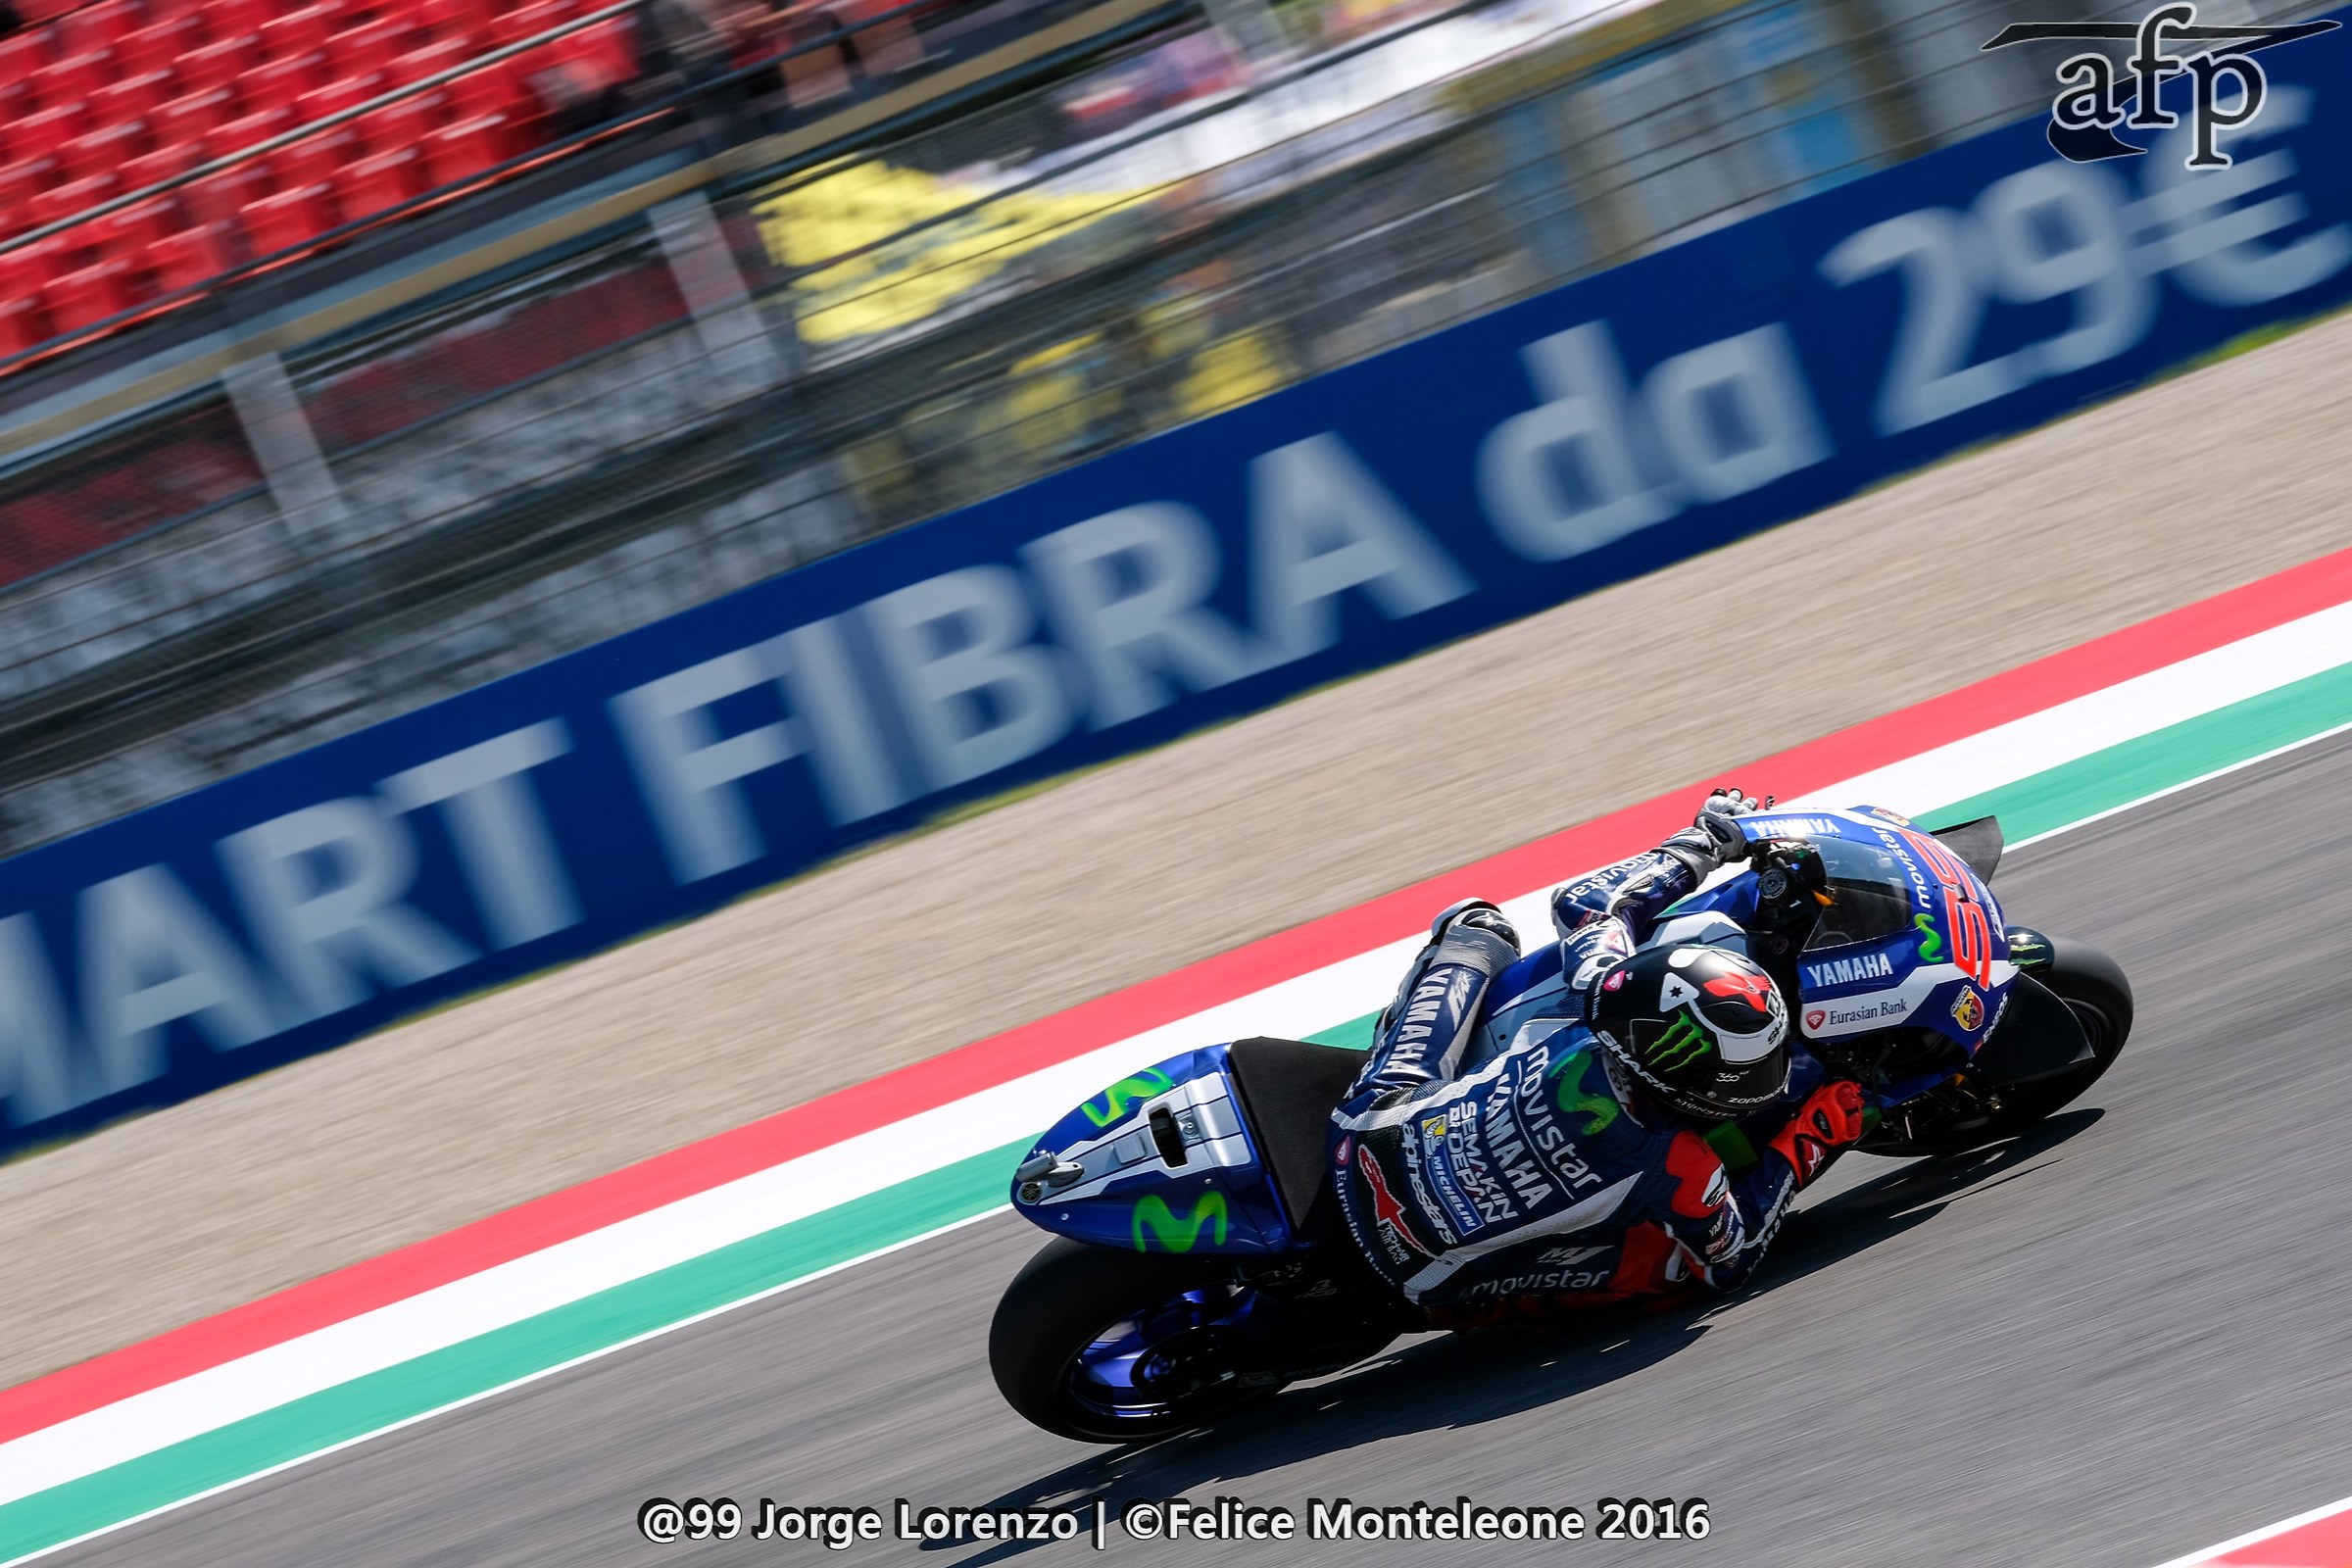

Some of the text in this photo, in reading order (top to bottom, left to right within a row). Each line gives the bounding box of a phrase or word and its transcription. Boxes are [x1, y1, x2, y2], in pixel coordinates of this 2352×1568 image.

[606, 430, 1477, 886] FIBRA
[1474, 318, 1838, 564] da
[1815, 85, 2352, 438] 29€
[1872, 826, 1932, 909] movistar
[1806, 953, 1893, 988] YAMAHA
[1379, 968, 1453, 1077] YAMAHA
[1829, 999, 1907, 1025] Eurasian Bank
[1596, 1030, 1678, 1093] SHARK
[1485, 1073, 1552, 1209] YAMAHA
[1520, 1046, 1602, 1189] movistar
[1335, 1168, 1364, 1250] Eurasian
[1401, 1123, 1458, 1246] alpinestars
[1433, 1155, 1477, 1228] MICHELIN
[1470, 1269, 1610, 1297] movistar
